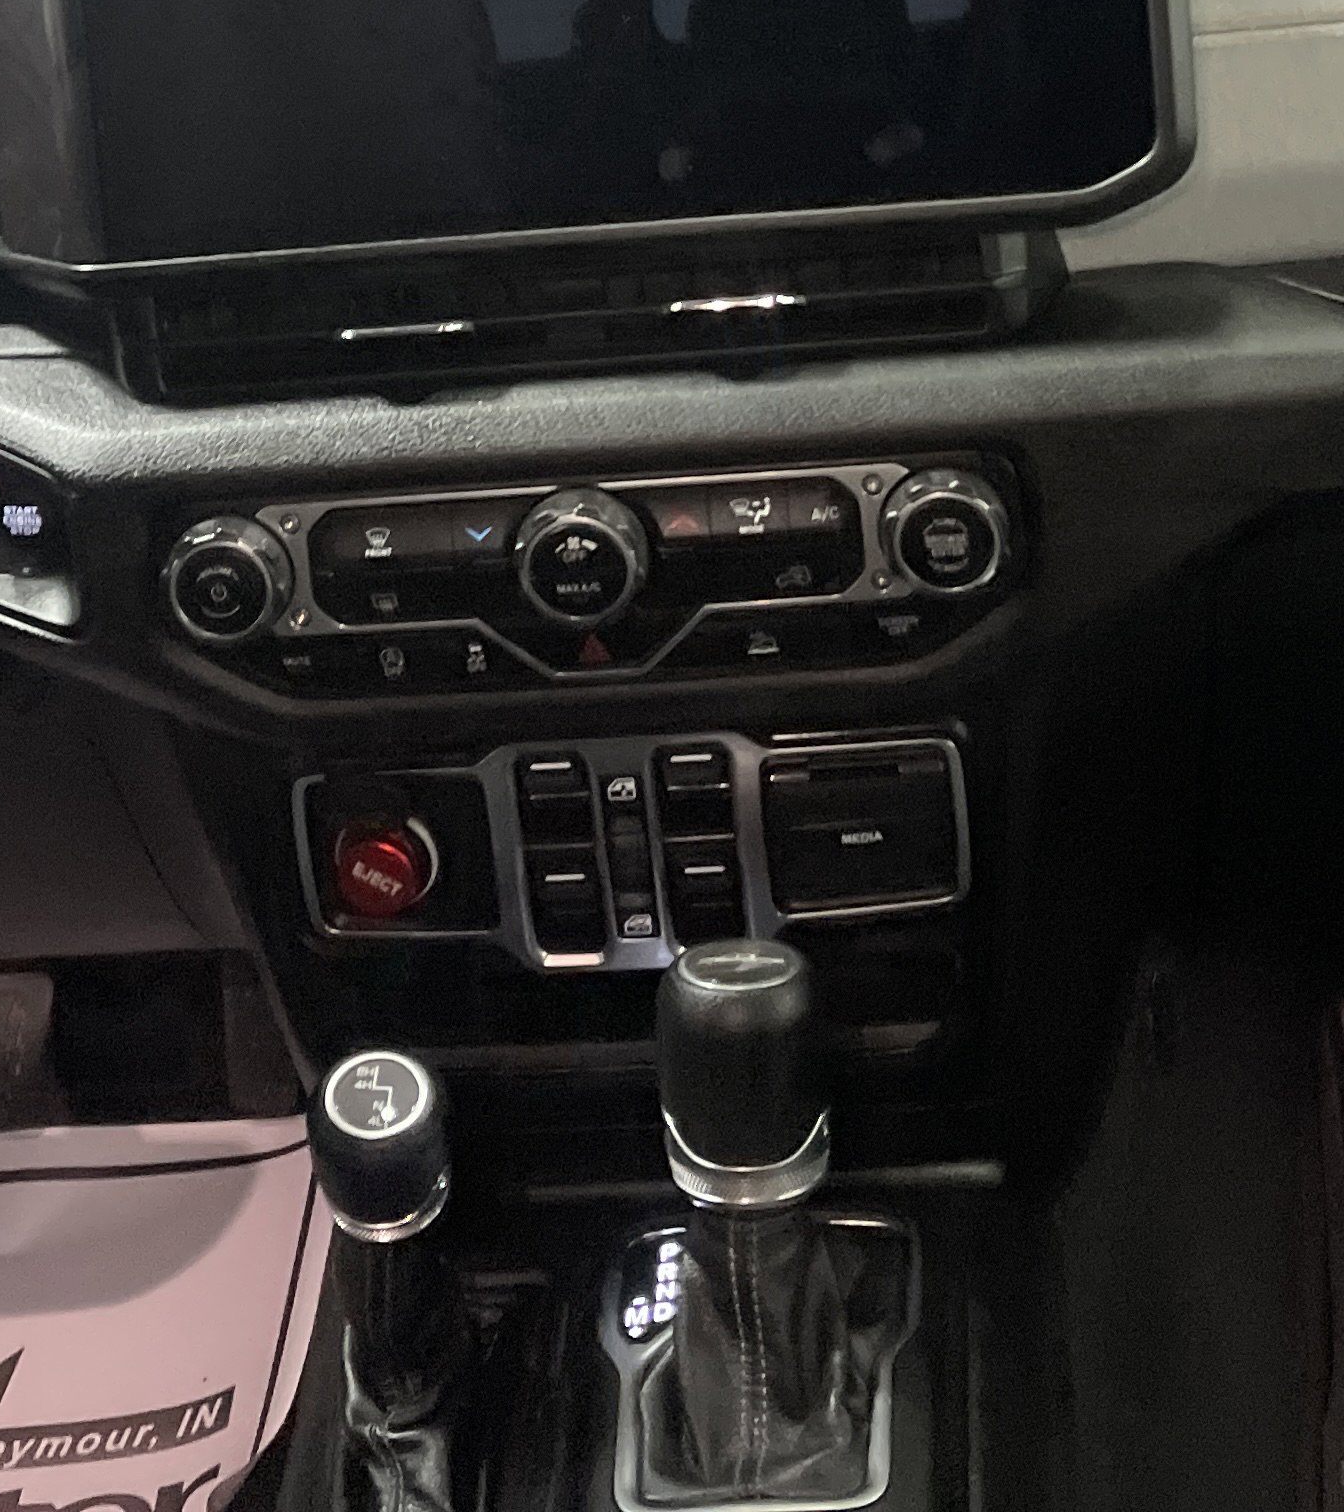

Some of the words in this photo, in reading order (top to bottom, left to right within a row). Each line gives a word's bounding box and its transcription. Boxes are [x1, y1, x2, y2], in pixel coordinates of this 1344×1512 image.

[811, 505, 840, 523] A/C
[352, 860, 404, 896] EJECT
[176, 1397, 224, 1439] IN
